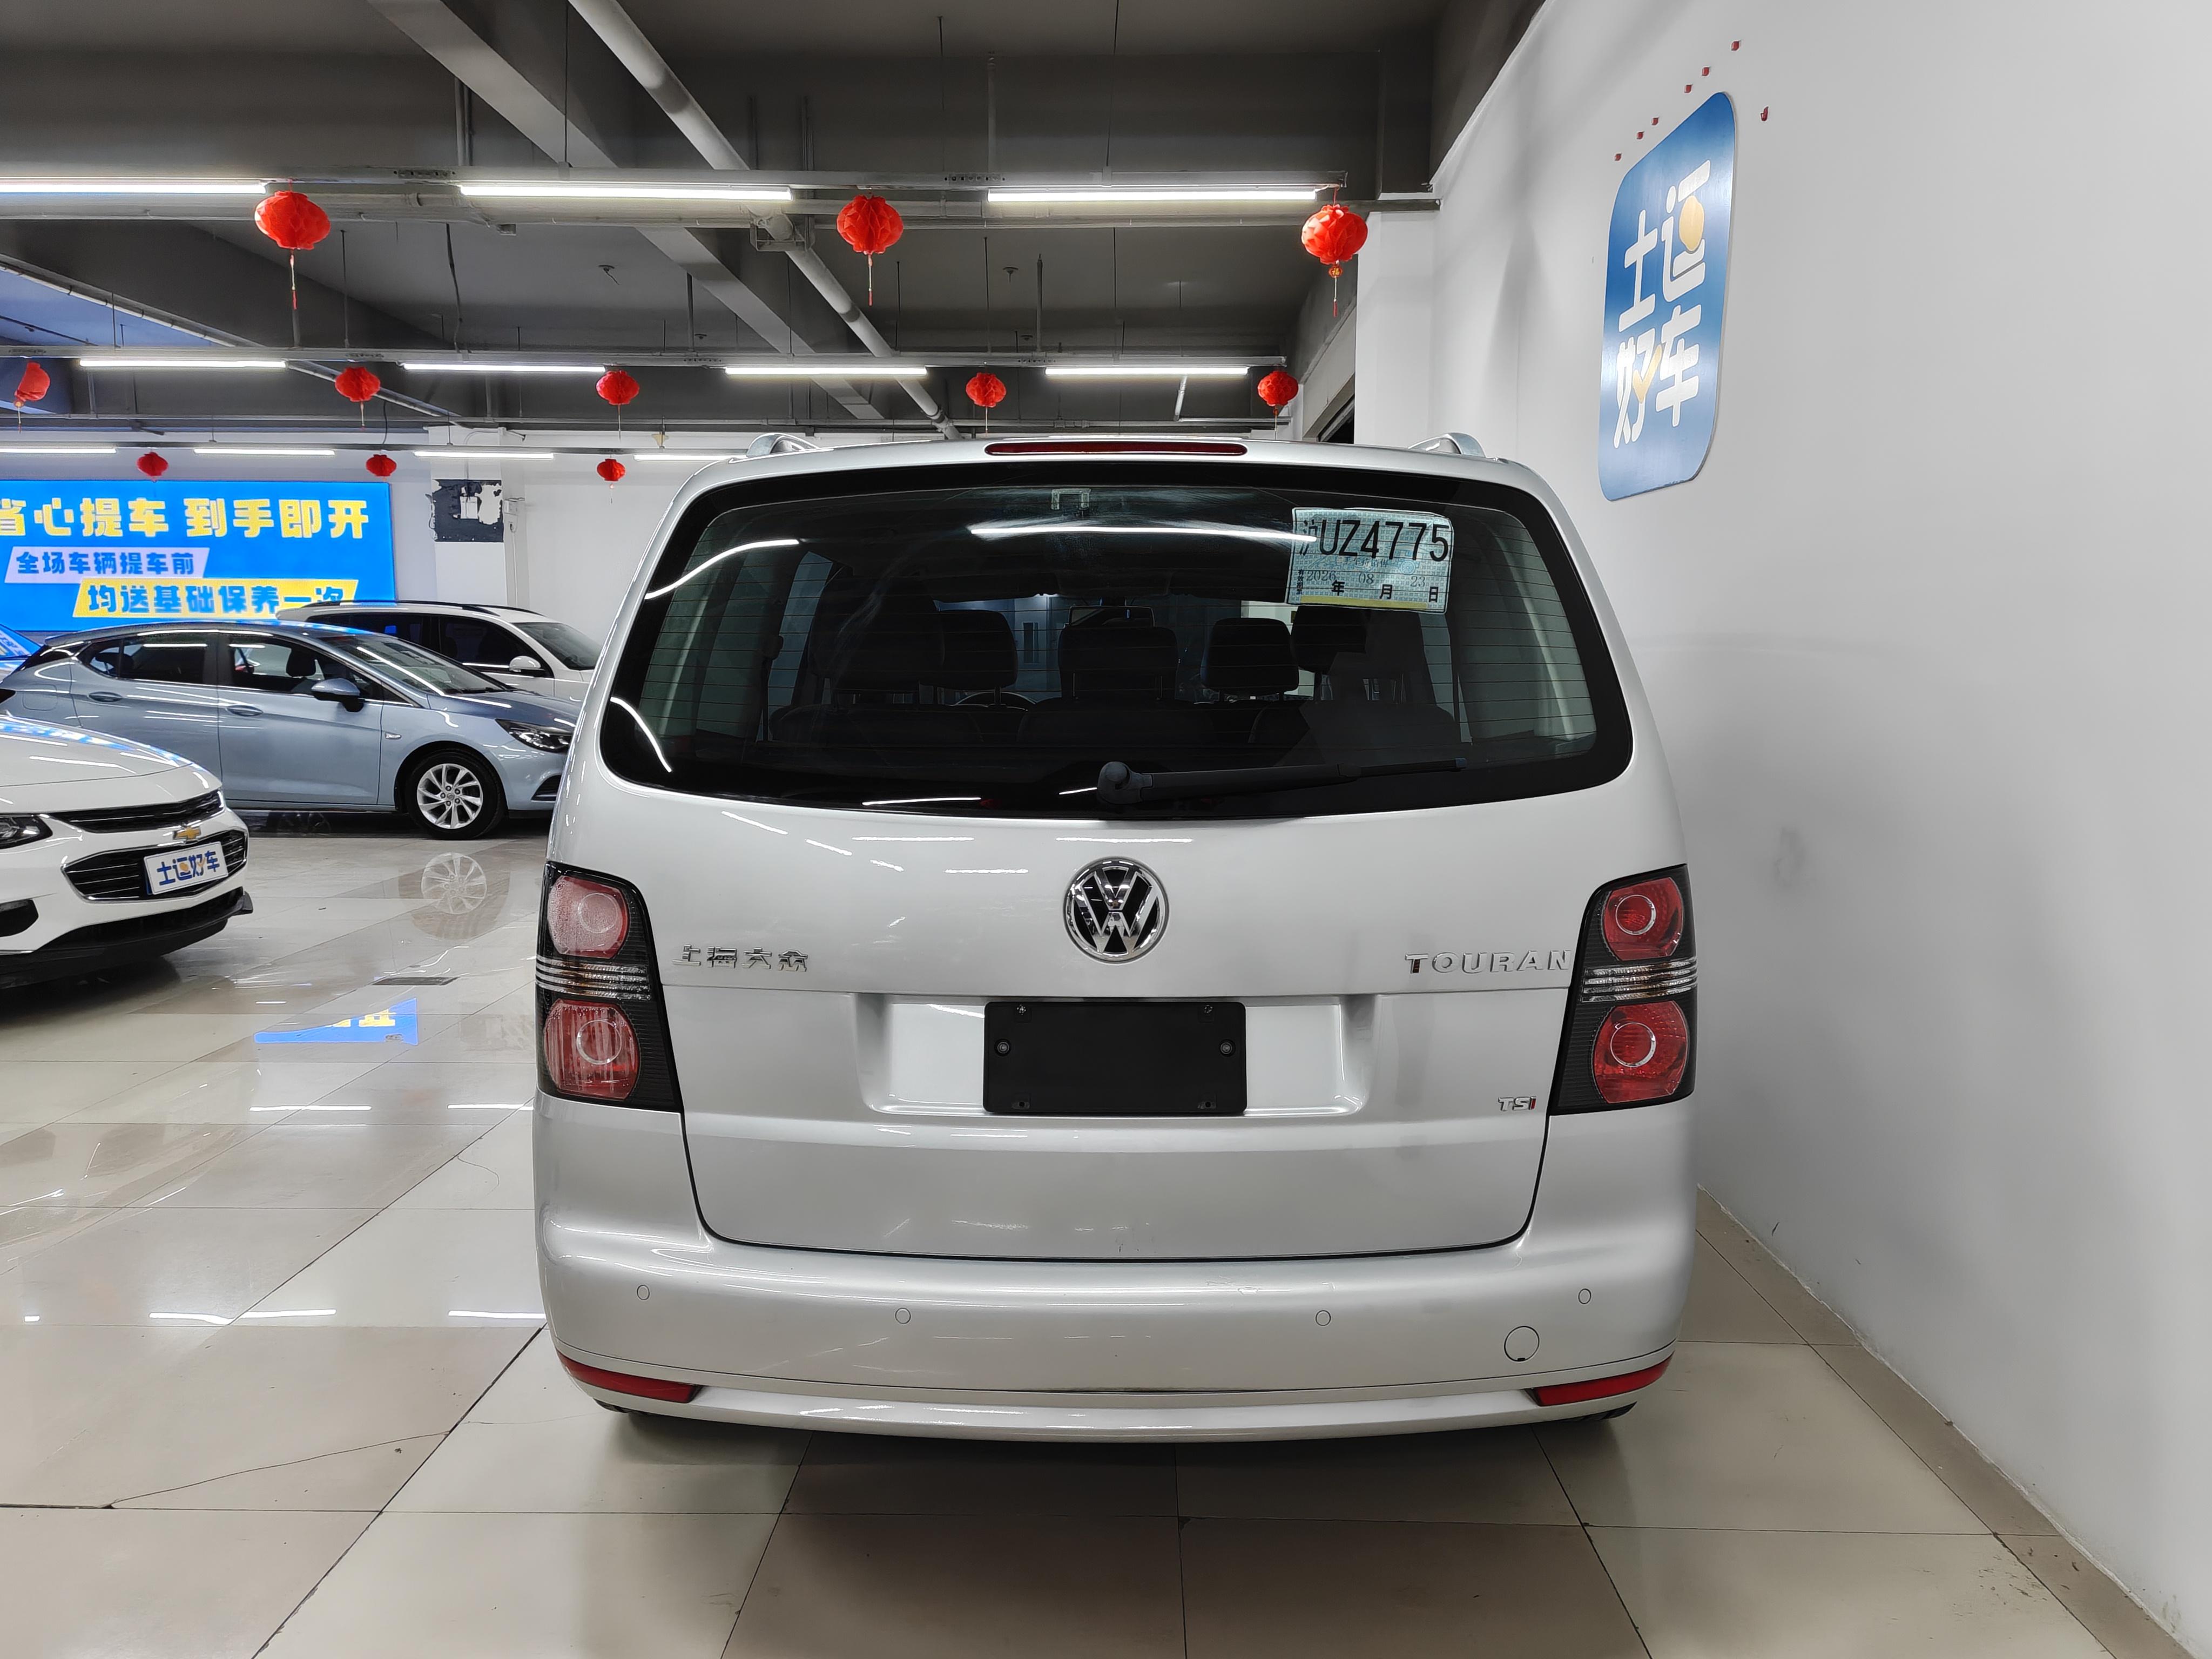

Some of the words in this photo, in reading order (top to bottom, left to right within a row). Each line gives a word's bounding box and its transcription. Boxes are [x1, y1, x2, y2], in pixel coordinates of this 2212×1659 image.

[1614, 304, 1702, 449] 好车
[0, 497, 168, 537] 省心提车
[184, 498, 369, 539] 到手即开
[1299, 520, 1450, 562] 沪UZ4775
[16, 551, 195, 575] 全场车辆提车前
[1331, 579, 1345, 596] 年
[1379, 584, 1393, 599] 月
[1428, 586, 1439, 603] 日
[671, 945, 808, 972] 上海大众
[1405, 950, 1572, 974] TOURAN
